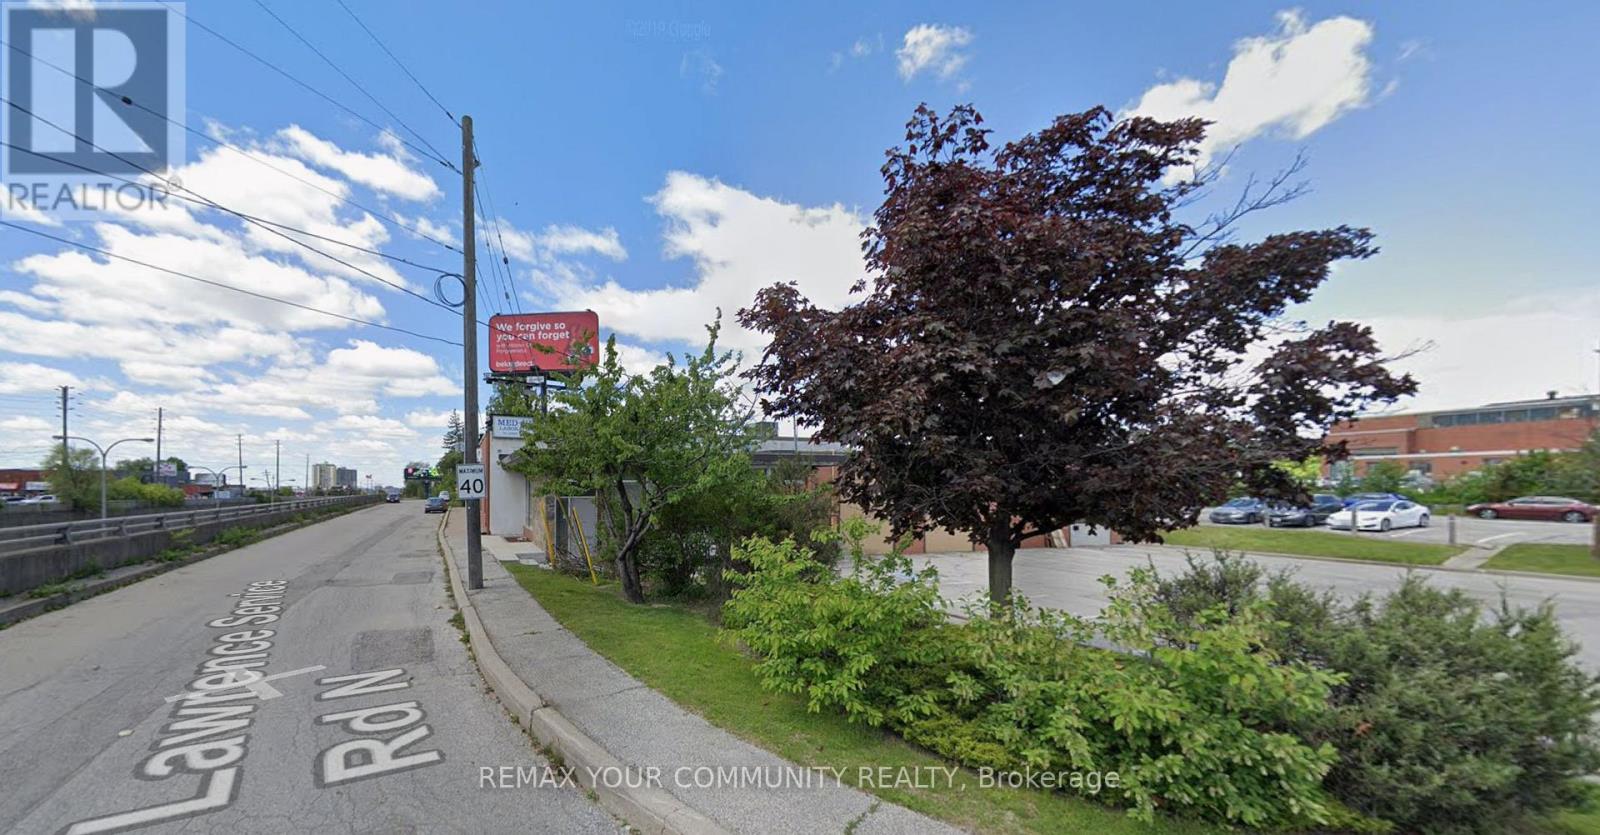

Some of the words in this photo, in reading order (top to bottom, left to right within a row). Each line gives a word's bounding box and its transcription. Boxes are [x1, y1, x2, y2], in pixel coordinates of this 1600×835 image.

[496, 323, 513, 332] We
[516, 322, 551, 333] forgive
[554, 322, 566, 330] so
[496, 333, 515, 343] you
[518, 333, 535, 341] can
[538, 330, 570, 341] forget
[497, 419, 517, 427] MED
[460, 478, 484, 495] 40
